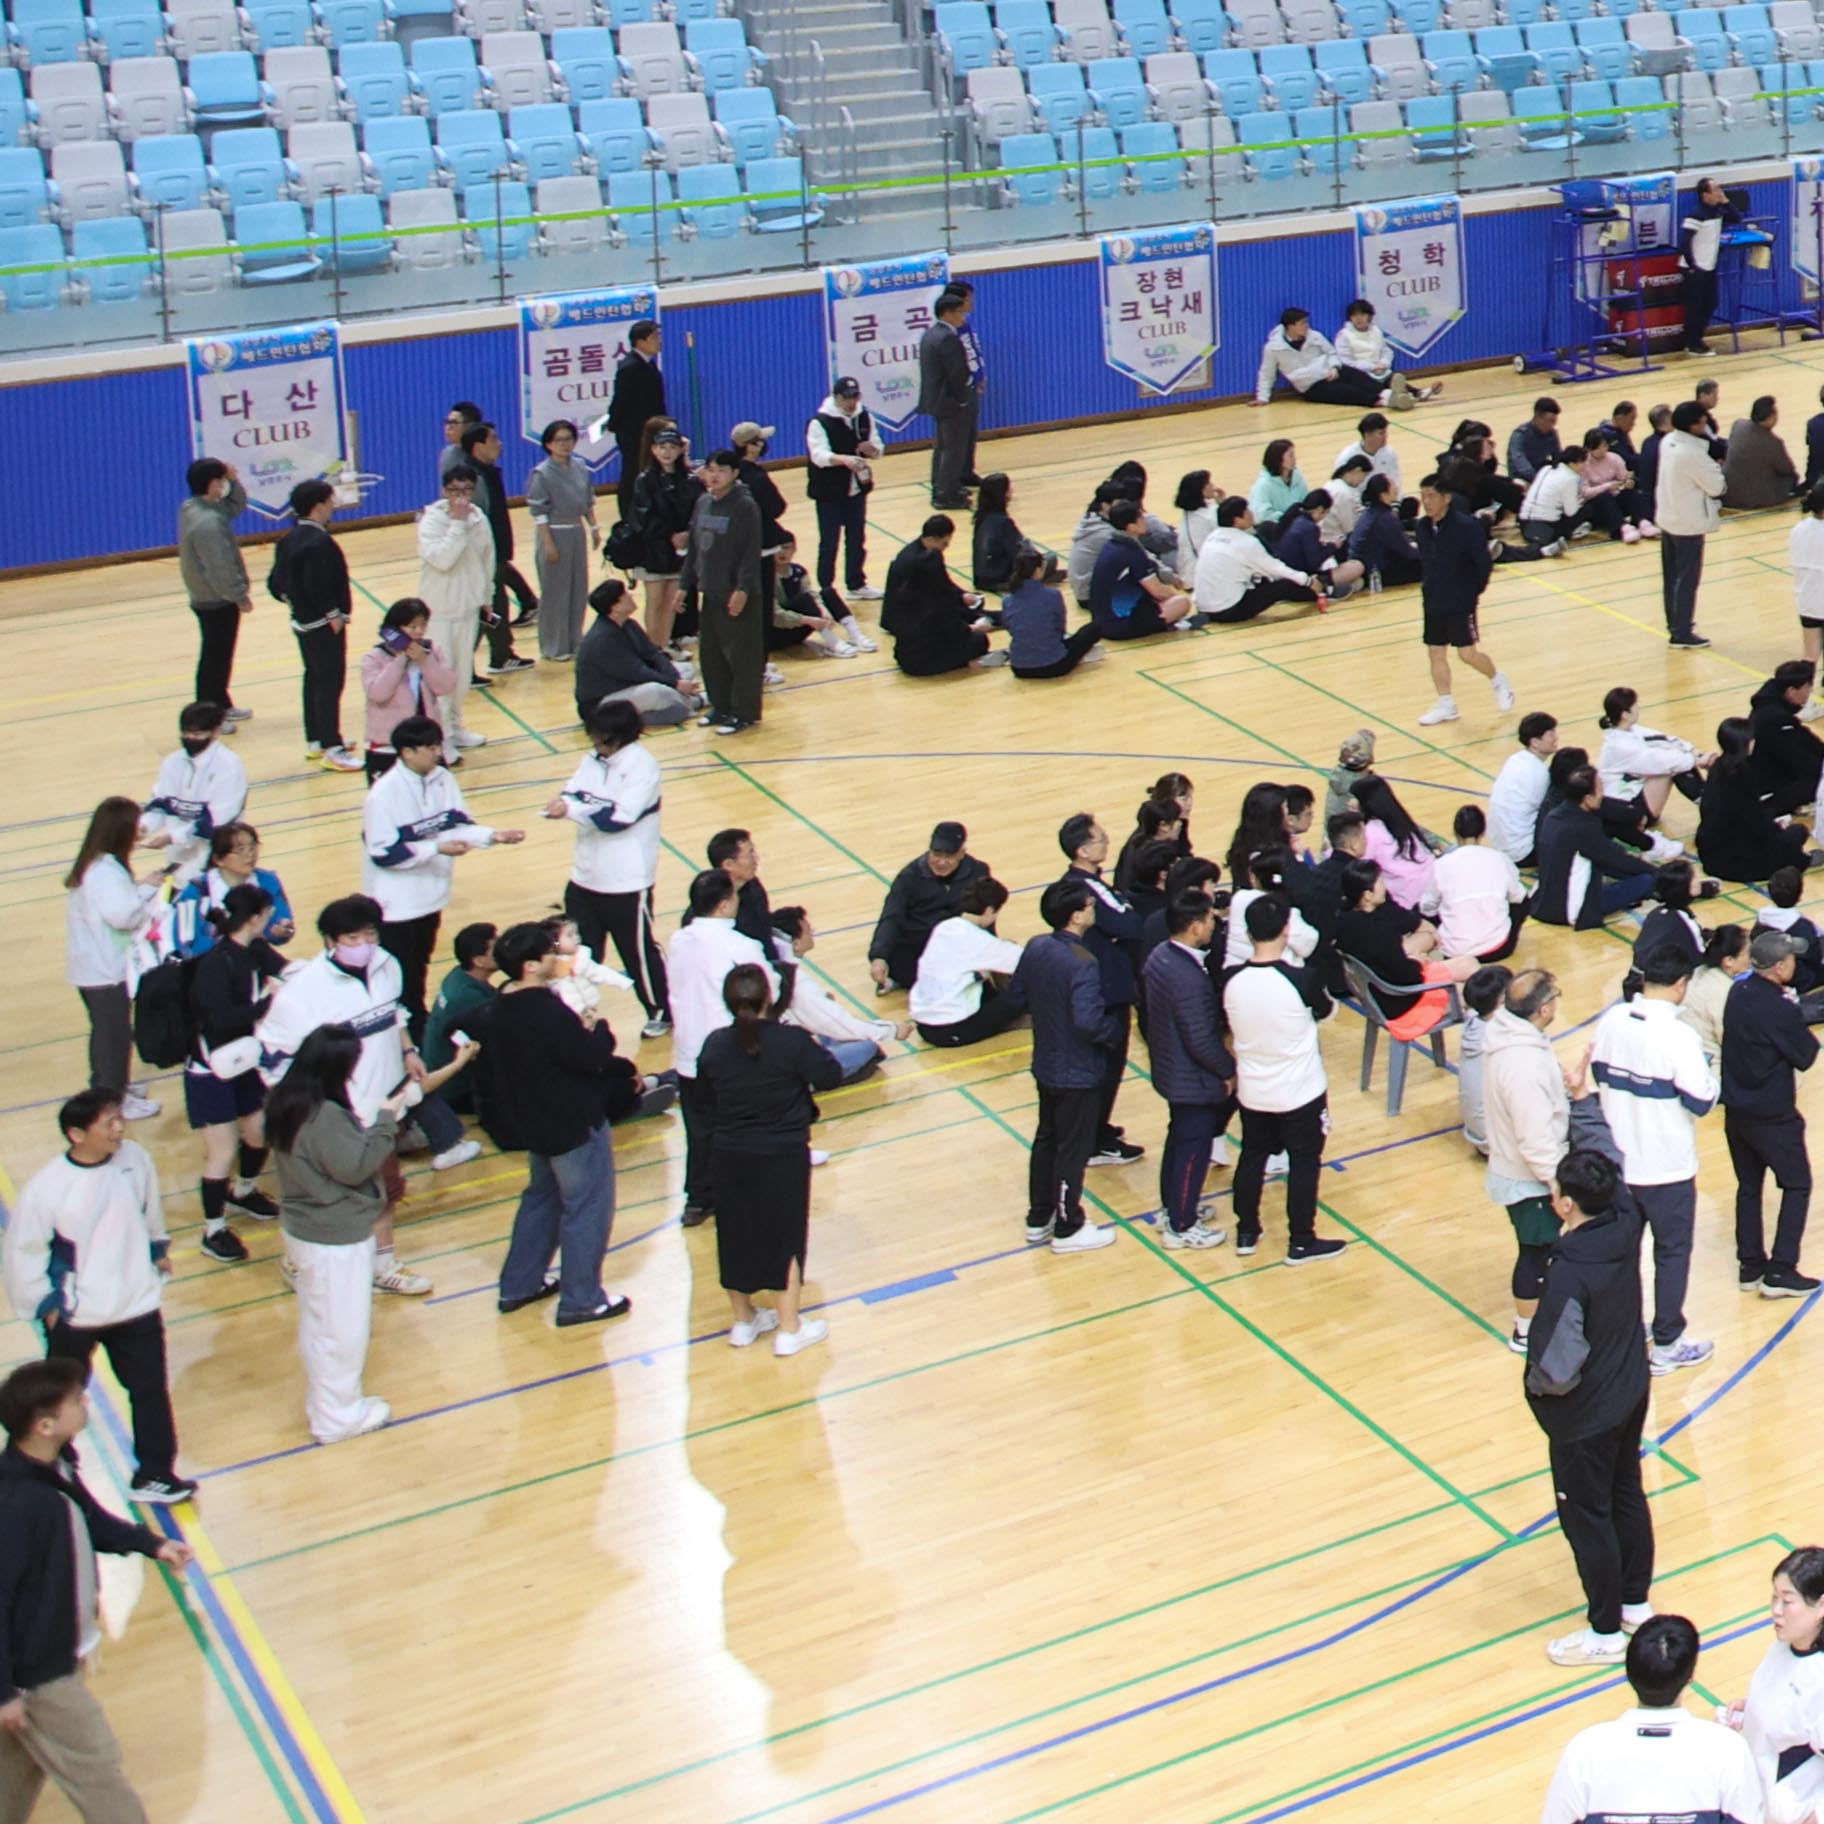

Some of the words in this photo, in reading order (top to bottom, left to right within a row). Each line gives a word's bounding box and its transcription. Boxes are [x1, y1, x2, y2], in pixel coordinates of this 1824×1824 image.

[1378, 248, 1402, 276] 청
[1422, 241, 1446, 268] 학
[1136, 266, 1185, 294] 장현
[1386, 275, 1441, 298] CLUB
[1119, 290, 1203, 323] 크낙새
[851, 313, 879, 343] 금
[904, 306, 932, 331] 곡
[1137, 321, 1187, 341] CLUB
[220, 389, 255, 420] 다
[285, 379, 320, 413] 산
[232, 420, 312, 449] CLUB
